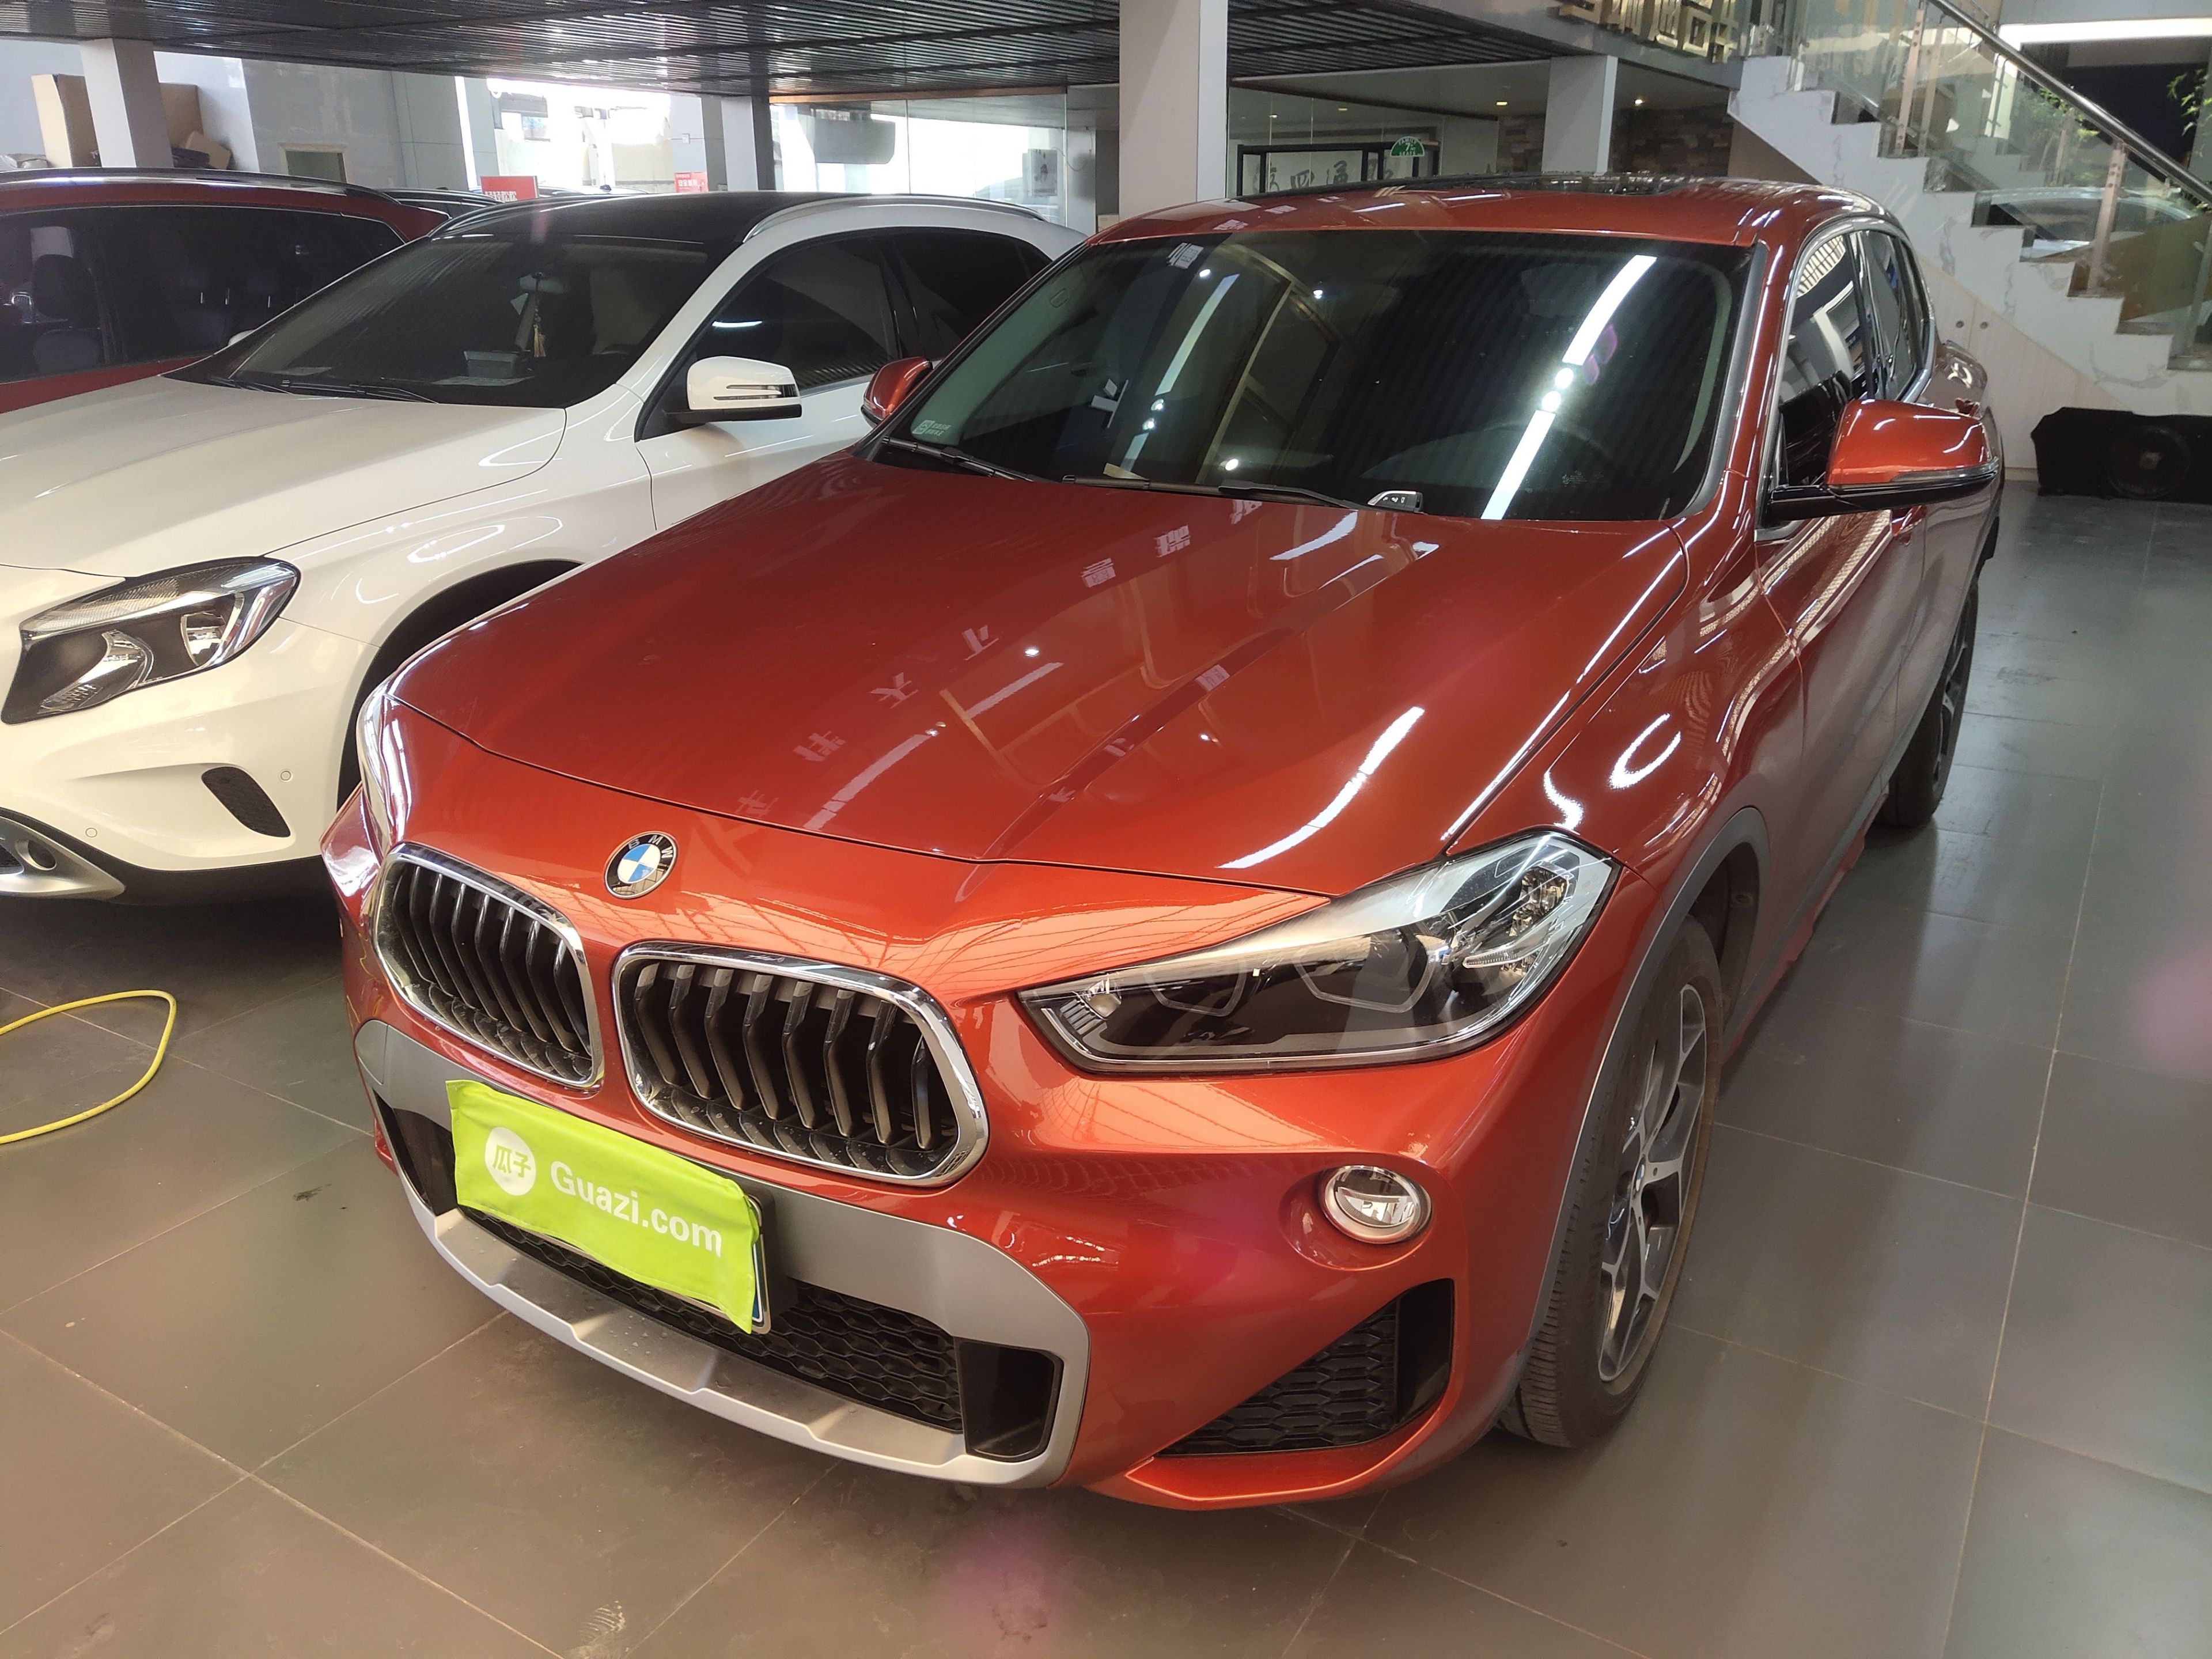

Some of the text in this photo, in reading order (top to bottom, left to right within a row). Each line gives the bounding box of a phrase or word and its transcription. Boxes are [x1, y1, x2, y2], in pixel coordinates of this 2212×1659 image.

[628, 835, 673, 859] BMW
[493, 1144, 531, 1178] 瓜子
[550, 1161, 722, 1258] Guazi.com
